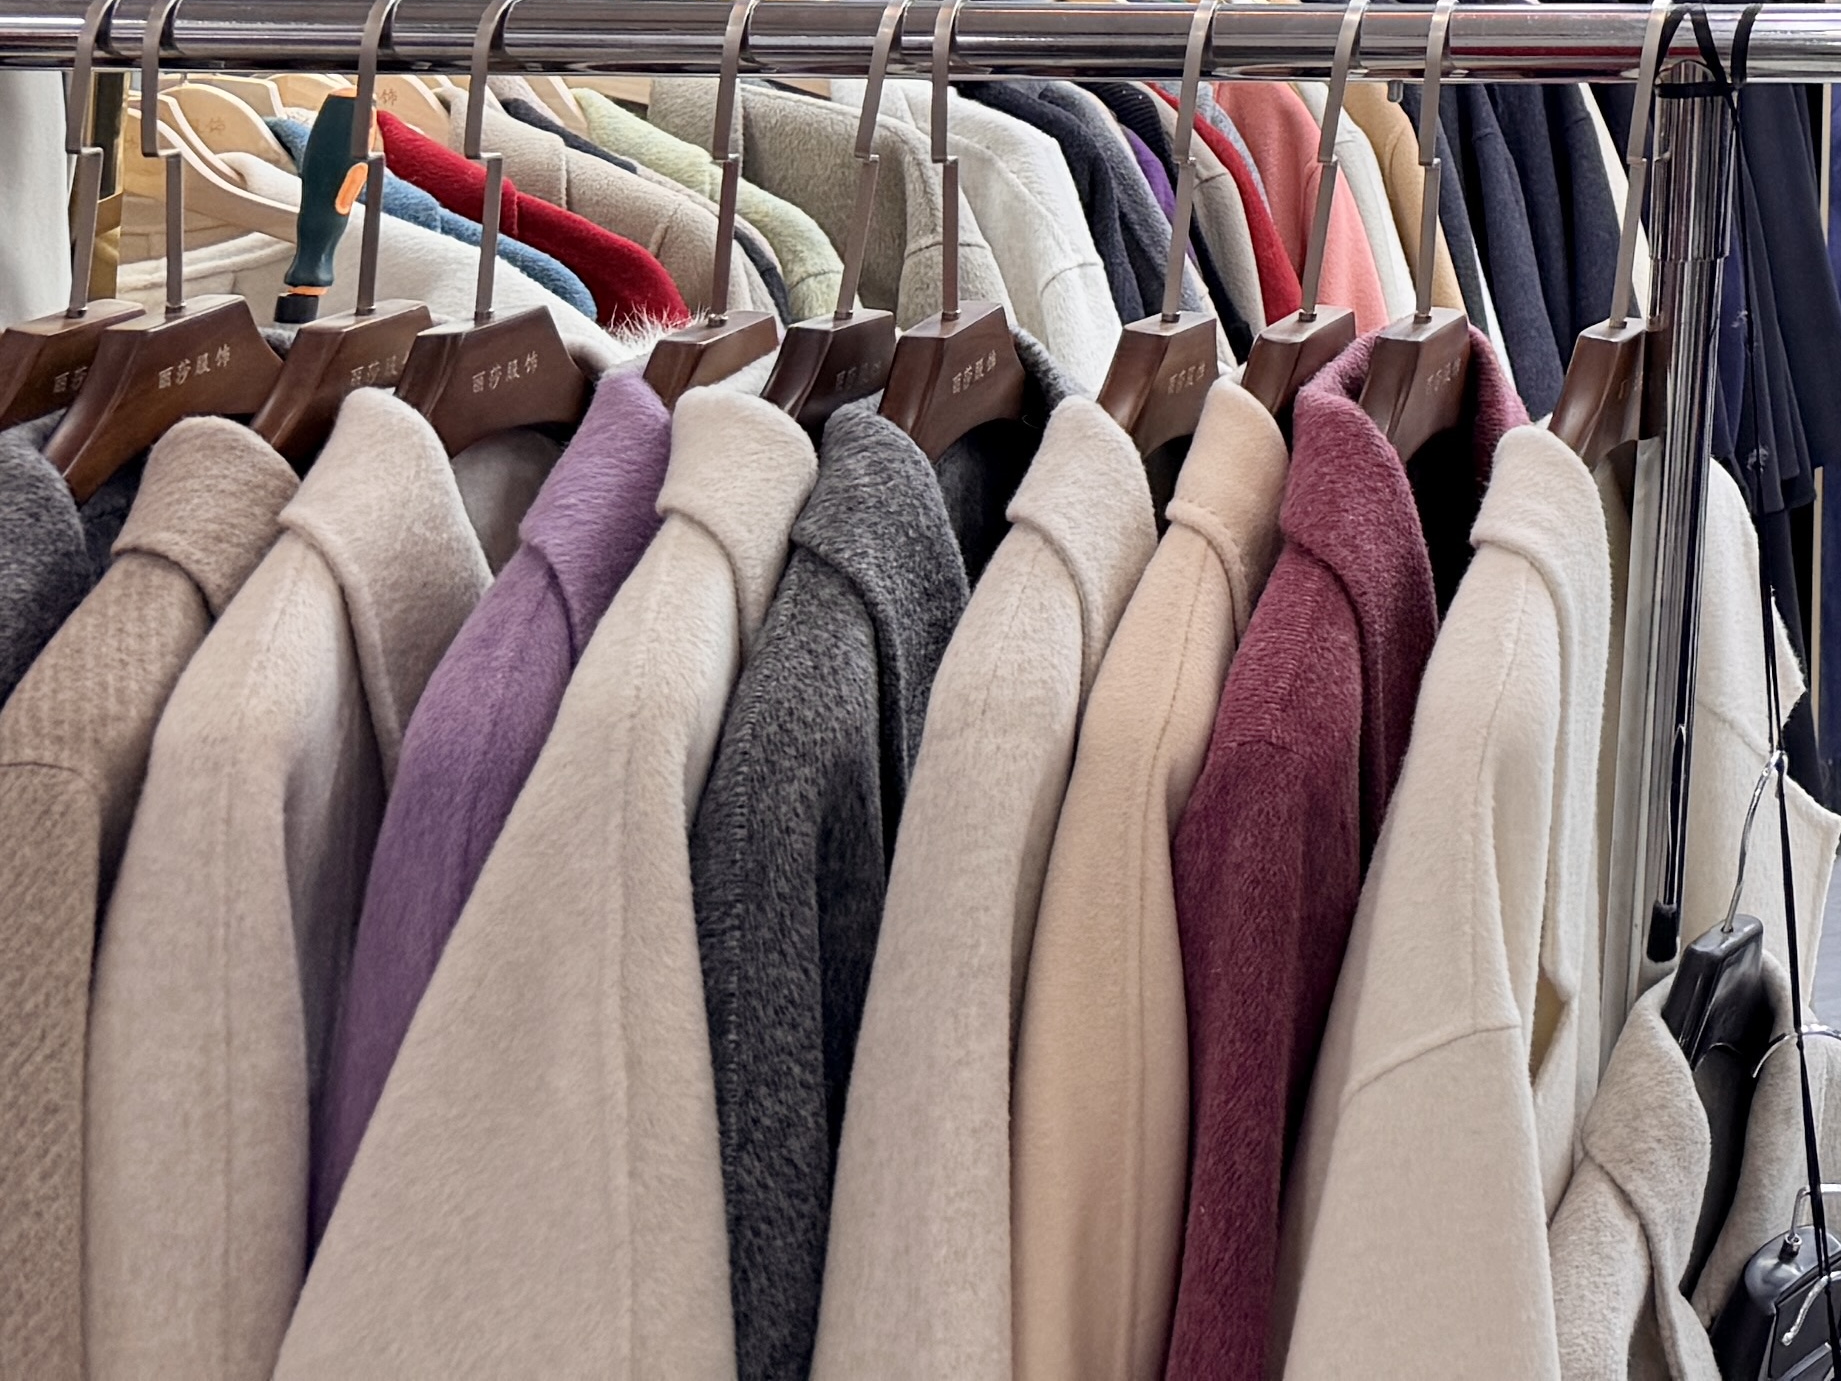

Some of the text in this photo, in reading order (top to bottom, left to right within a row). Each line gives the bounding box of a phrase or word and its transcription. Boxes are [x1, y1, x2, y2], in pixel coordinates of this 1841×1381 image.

[158, 343, 231, 389] 丽莎服饰
[350, 351, 409, 386] 丽莎服
[472, 350, 538, 393] 丽莎服饰
